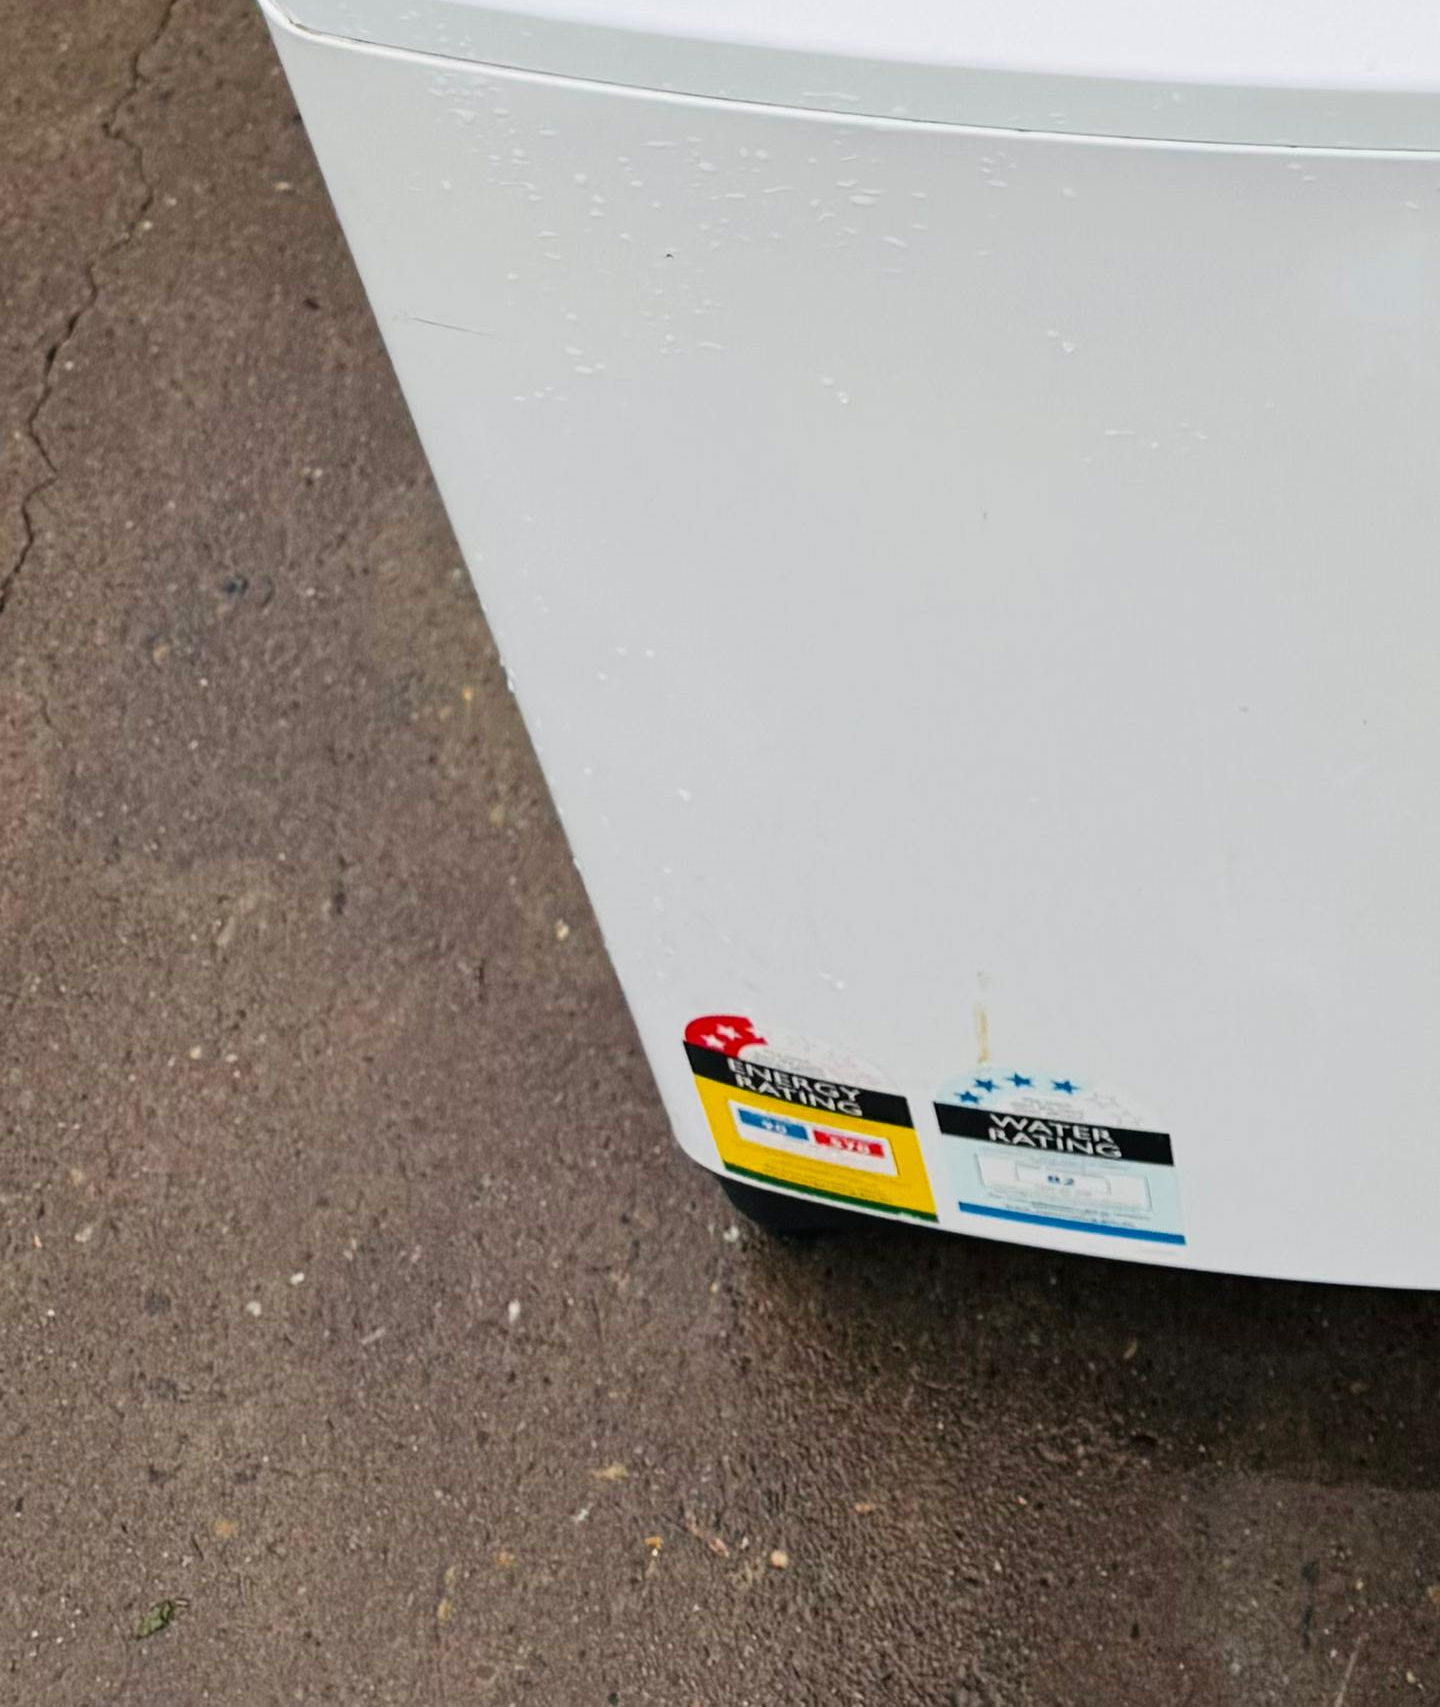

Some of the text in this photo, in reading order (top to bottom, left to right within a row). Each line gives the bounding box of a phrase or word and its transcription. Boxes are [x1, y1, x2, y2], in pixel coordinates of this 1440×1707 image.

[727, 1057, 861, 1102] ENERGY
[734, 1073, 863, 1117] RATING
[988, 1127, 1122, 1159] RATING
[990, 1113, 1115, 1143] WATER
